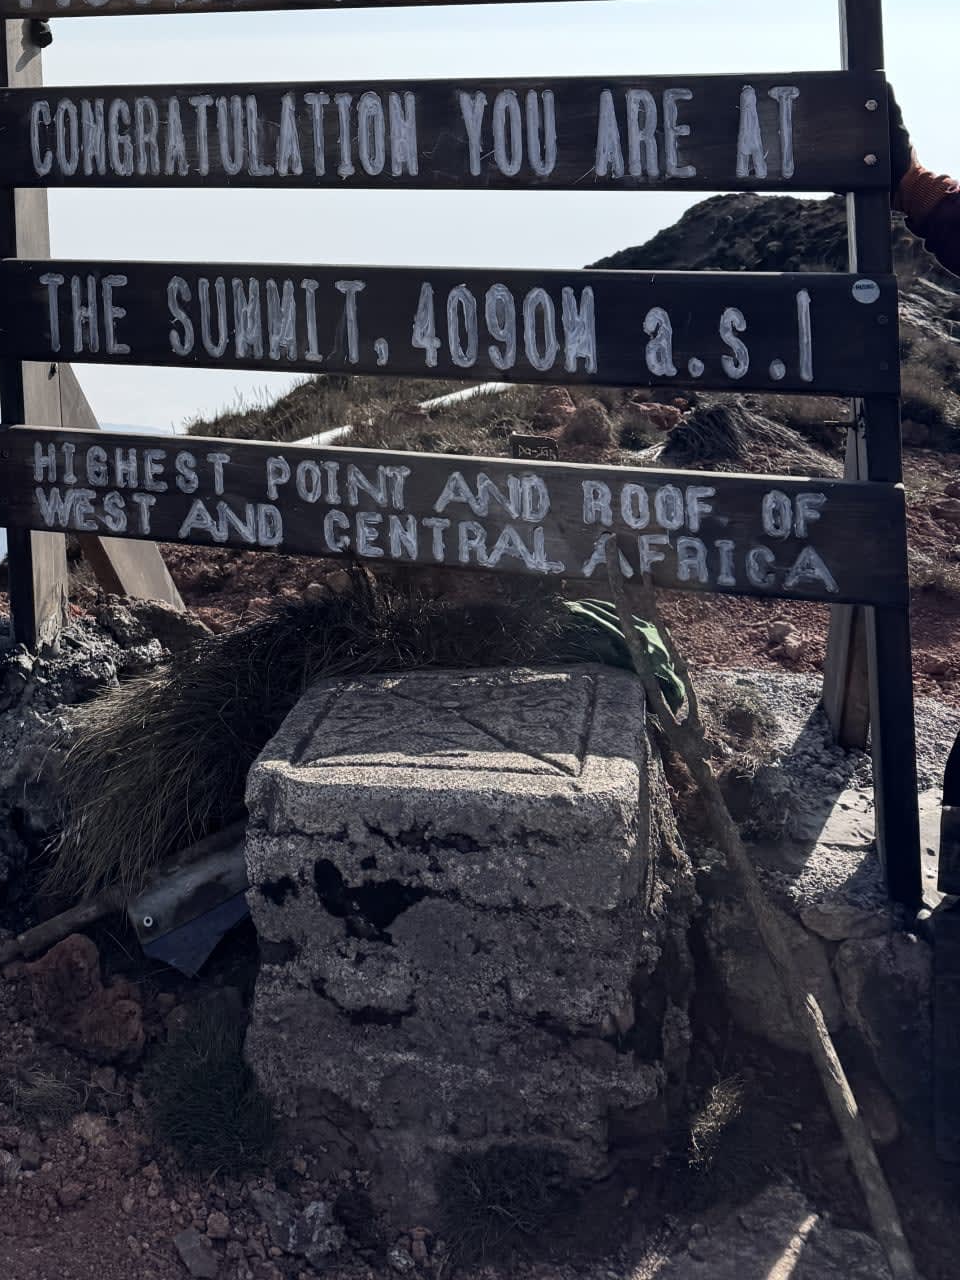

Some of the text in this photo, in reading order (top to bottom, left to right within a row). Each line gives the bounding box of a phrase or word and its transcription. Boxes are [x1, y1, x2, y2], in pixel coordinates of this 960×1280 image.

[30, 85, 800, 179] CONGRATULATION YOU ARE AT
[40, 272, 131, 354] THE
[33, 441, 231, 496] HIGHEST
[266, 455, 410, 510] POINT
[434, 471, 551, 522] AND
[762, 490, 828, 541] OF
[34, 486, 840, 594] WEST AND CENTRAL AFRICA
